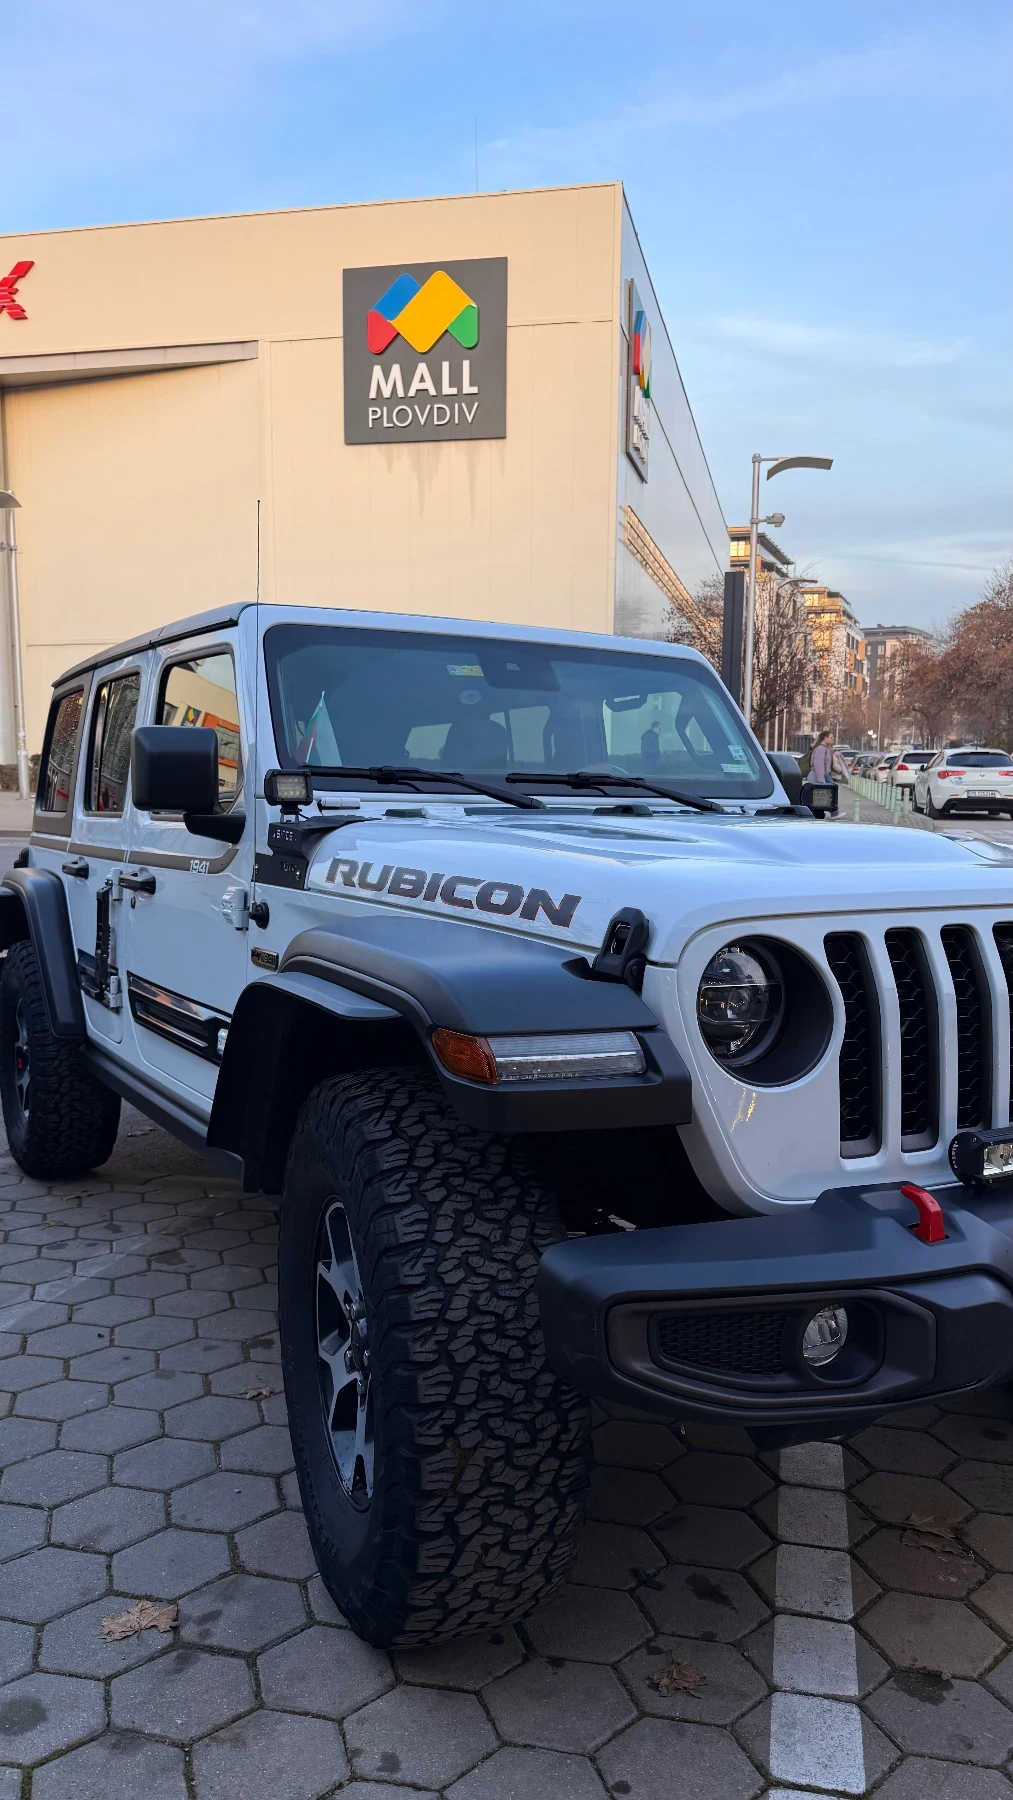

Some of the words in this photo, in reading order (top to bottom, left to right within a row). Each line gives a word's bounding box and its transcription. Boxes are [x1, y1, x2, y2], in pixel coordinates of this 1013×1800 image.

[369, 360, 479, 399] MALL
[367, 402, 479, 429] PLOVDIV
[189, 859, 210, 875] 1941
[325, 856, 582, 928] RUBICON
